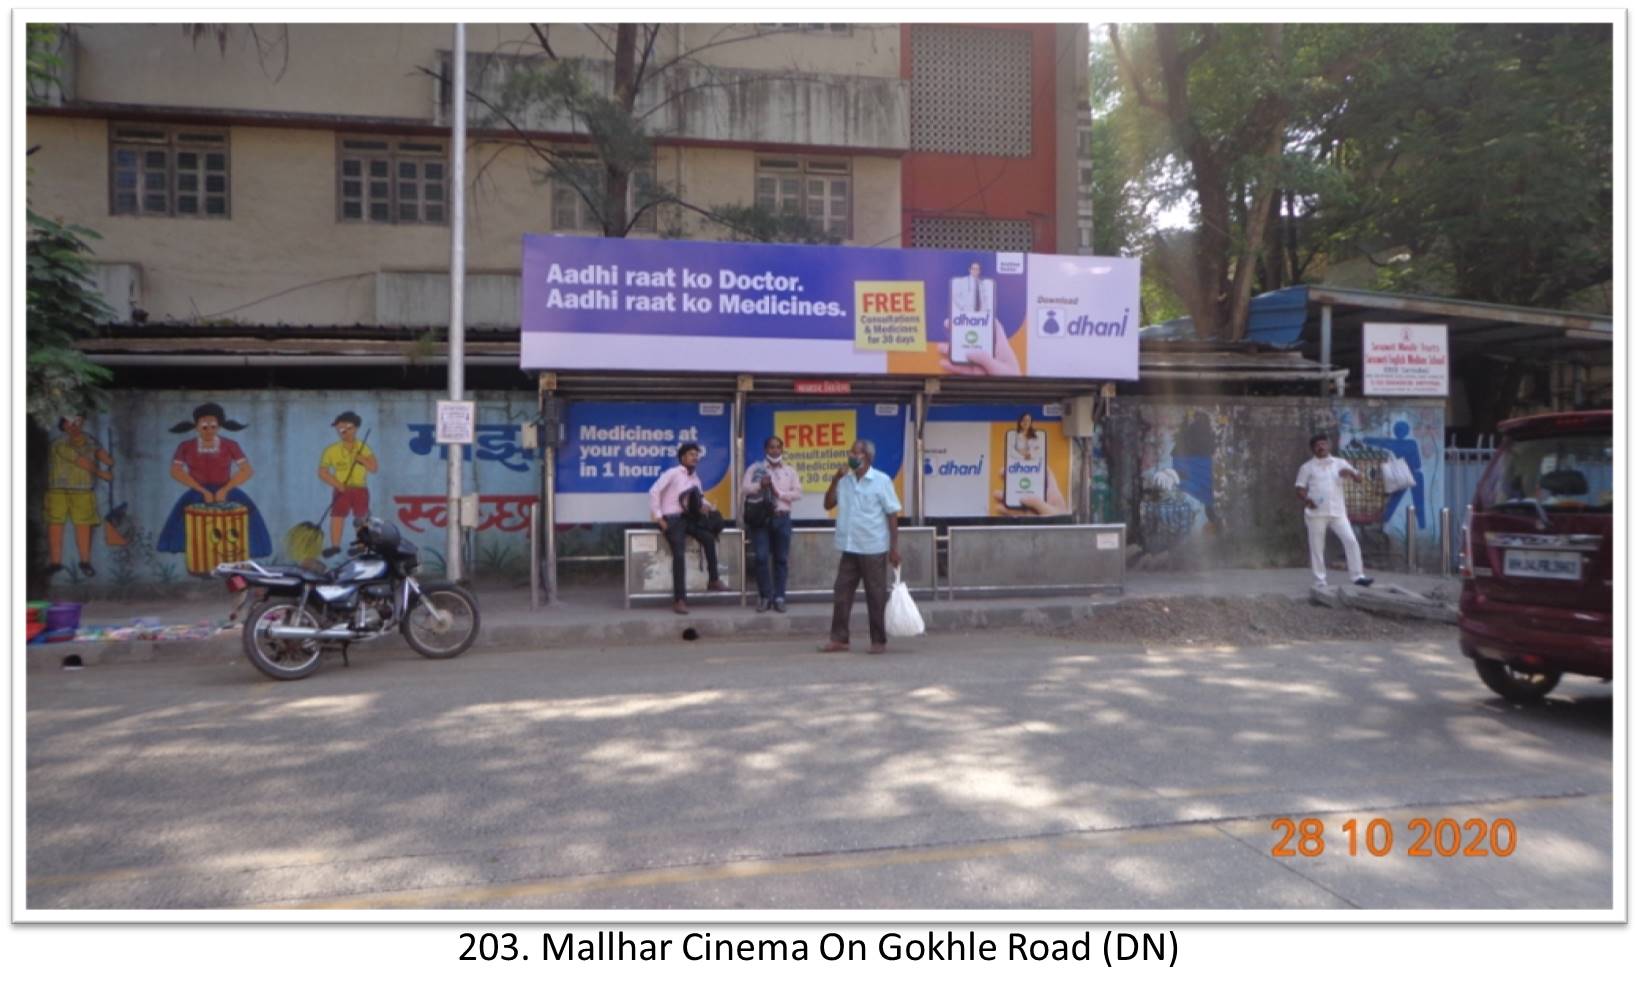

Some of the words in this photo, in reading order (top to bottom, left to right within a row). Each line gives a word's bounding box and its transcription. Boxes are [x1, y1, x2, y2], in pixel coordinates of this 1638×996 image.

[547, 263, 618, 286] Aadhi
[625, 267, 676, 288] raat
[682, 267, 712, 289] ko
[719, 269, 804, 291] Doctor.
[547, 288, 618, 311] Aadhi
[625, 291, 676, 312] raat
[682, 292, 712, 313] ko
[719, 294, 847, 317] Medicines.
[863, 290, 915, 313] FREE
[1036, 295, 1079, 305] Download
[860, 315, 920, 325] Consultations
[953, 309, 989, 327] dhani
[1067, 308, 1130, 337] dhani
[864, 325, 872, 334] &
[873, 325, 918, 334] Medicines
[867, 335, 880, 344] for
[881, 335, 894, 344] 30
[895, 335, 915, 346] days
[580, 425, 674, 441] Medicines
[679, 425, 698, 441] at
[783, 422, 846, 448] FREE
[579, 445, 622, 459] your
[580, 462, 597, 477] in
[602, 462, 614, 477] 1
[938, 454, 985, 476] dhani
[1008, 457, 1042, 475] dhani
[806, 472, 819, 484] 30
